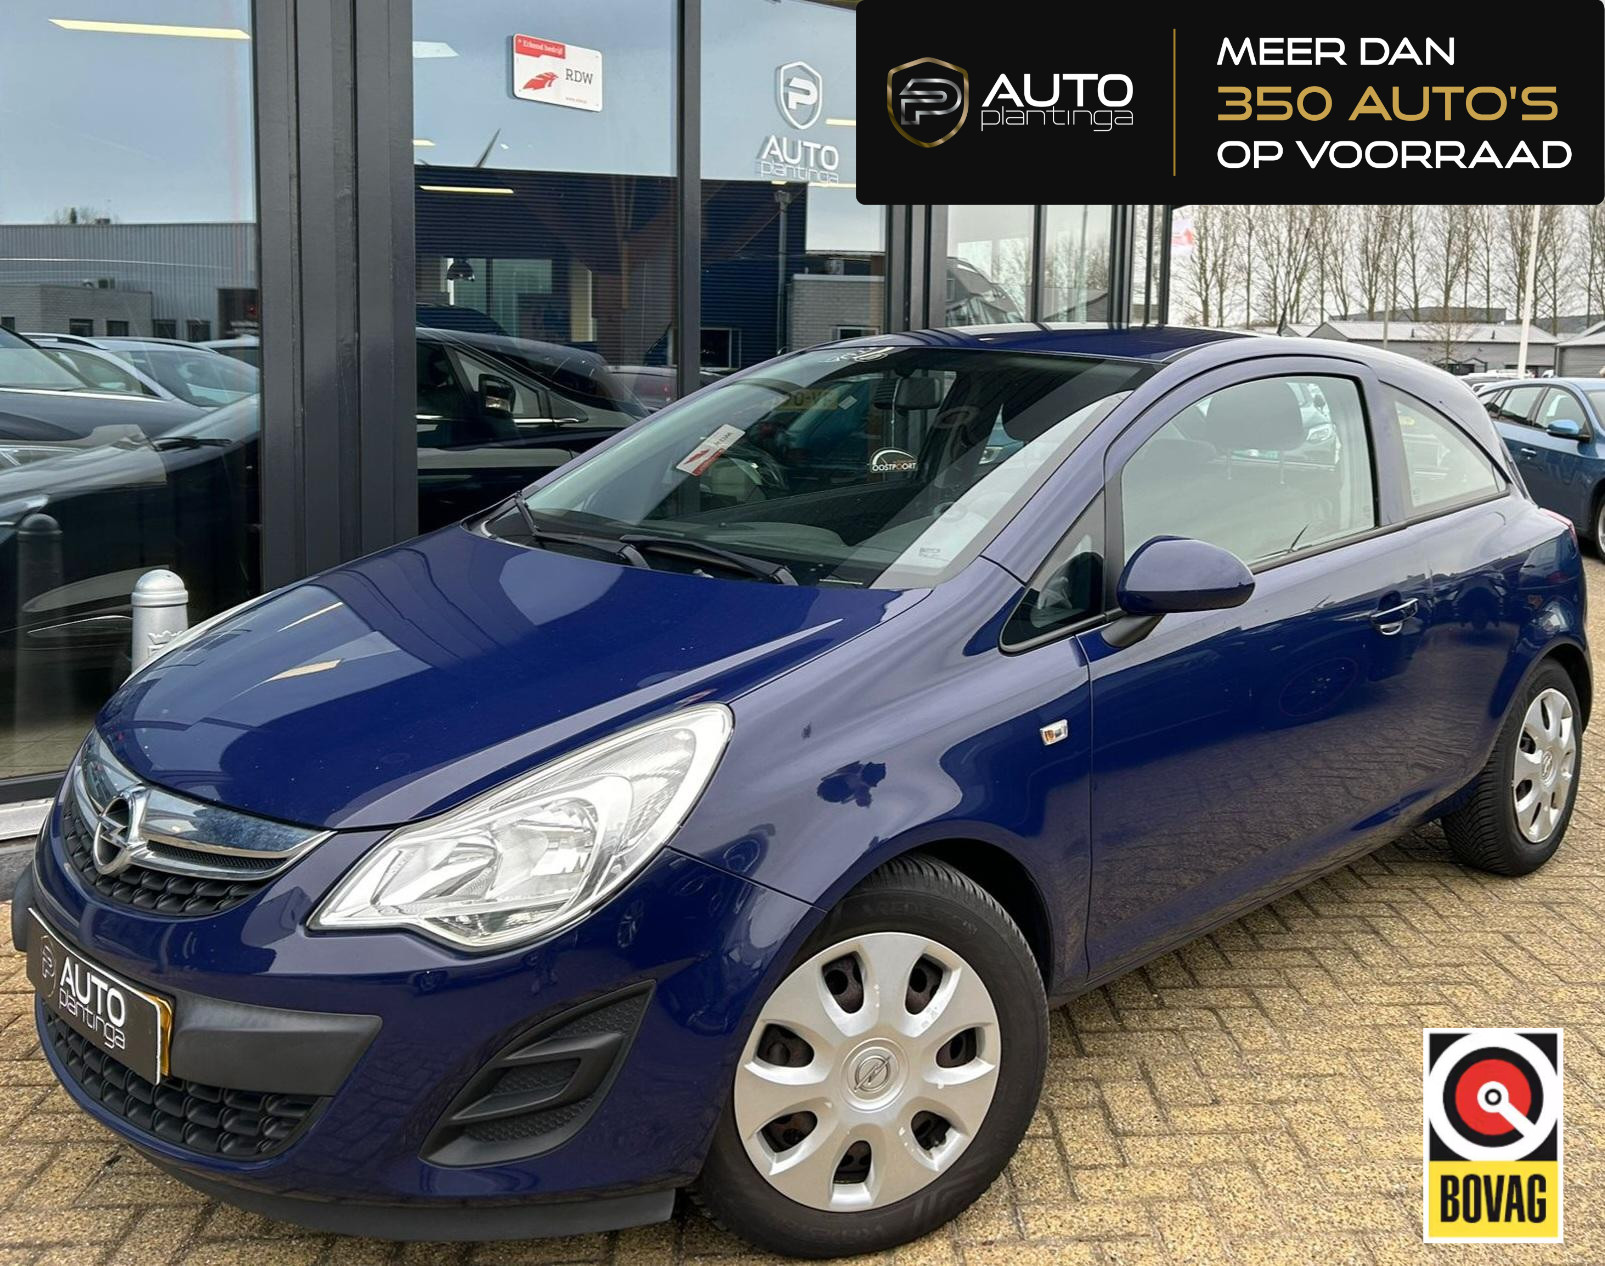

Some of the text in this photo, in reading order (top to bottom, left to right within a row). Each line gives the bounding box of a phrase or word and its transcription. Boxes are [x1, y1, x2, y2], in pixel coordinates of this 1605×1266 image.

[565, 68, 594, 85] RDW
[761, 134, 839, 171] AUTO
[872, 462, 917, 472] OOSTPOORT
[59, 956, 126, 1028] AUTO
[58, 987, 126, 1050] plantinga
